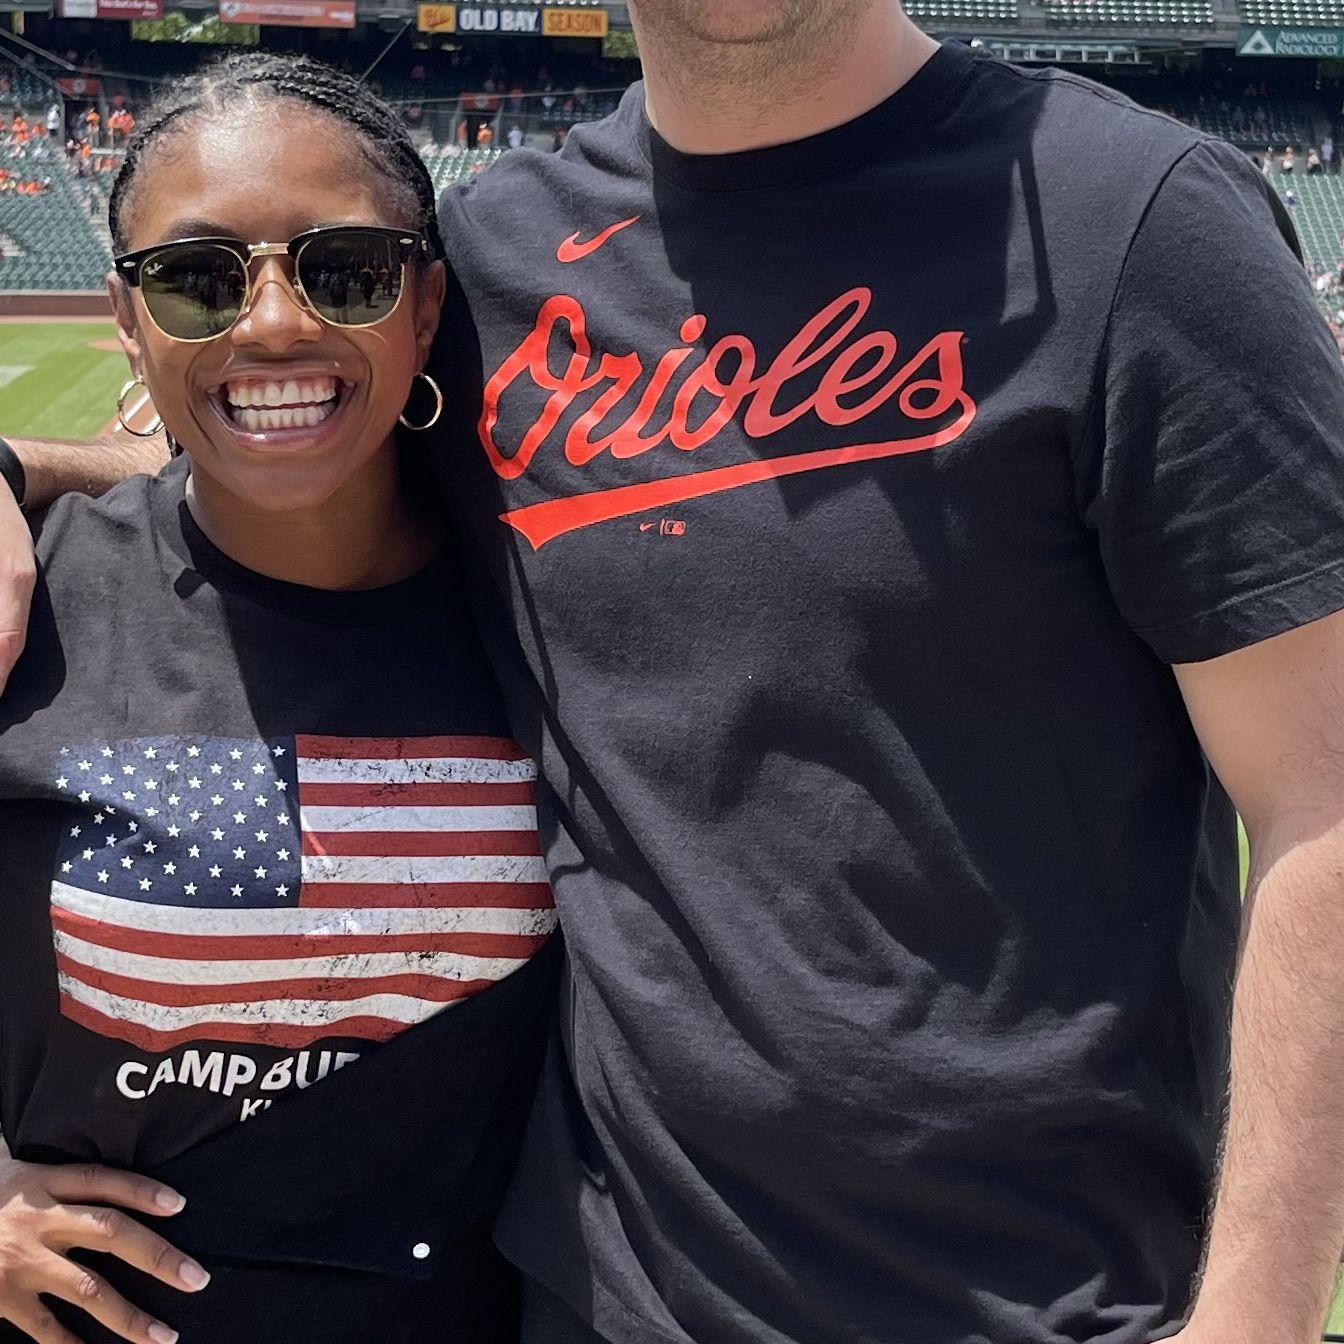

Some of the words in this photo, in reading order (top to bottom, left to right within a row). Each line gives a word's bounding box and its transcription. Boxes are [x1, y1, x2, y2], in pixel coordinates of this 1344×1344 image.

[459, 8, 499, 31] OLD
[500, 9, 540, 33] BAY
[548, 12, 603, 33] SEASON
[478, 286, 977, 480] Orioles
[116, 1049, 257, 1099] CAMP
